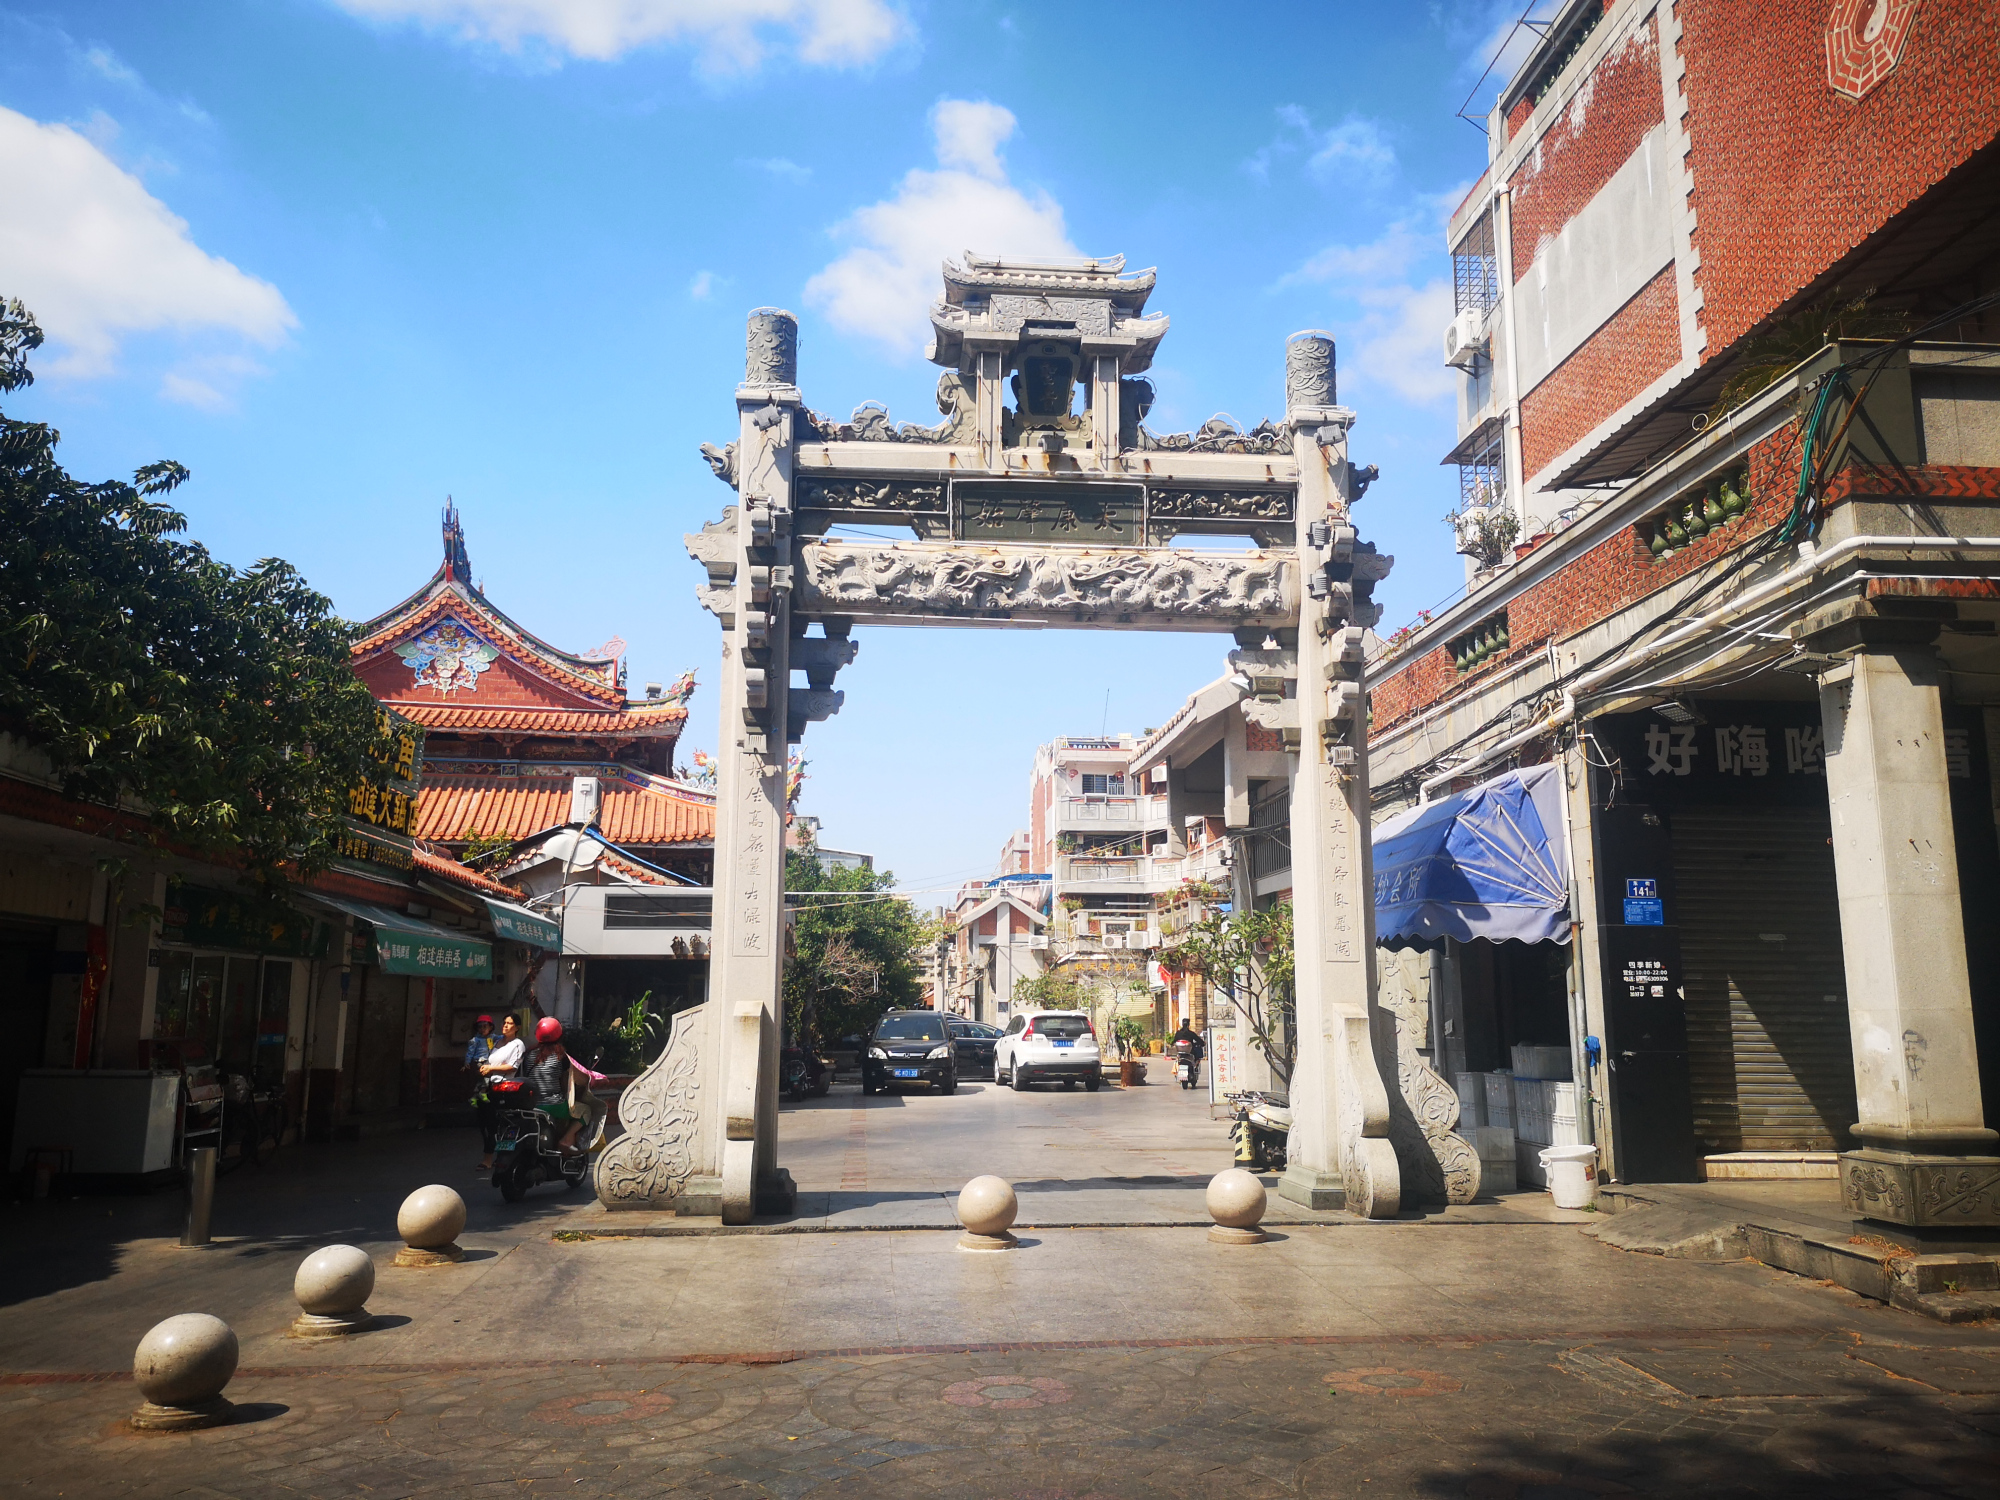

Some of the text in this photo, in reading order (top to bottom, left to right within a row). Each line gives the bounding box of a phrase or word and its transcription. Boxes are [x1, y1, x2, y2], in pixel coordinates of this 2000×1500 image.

[417, 944, 461, 968] 相逢串串香
